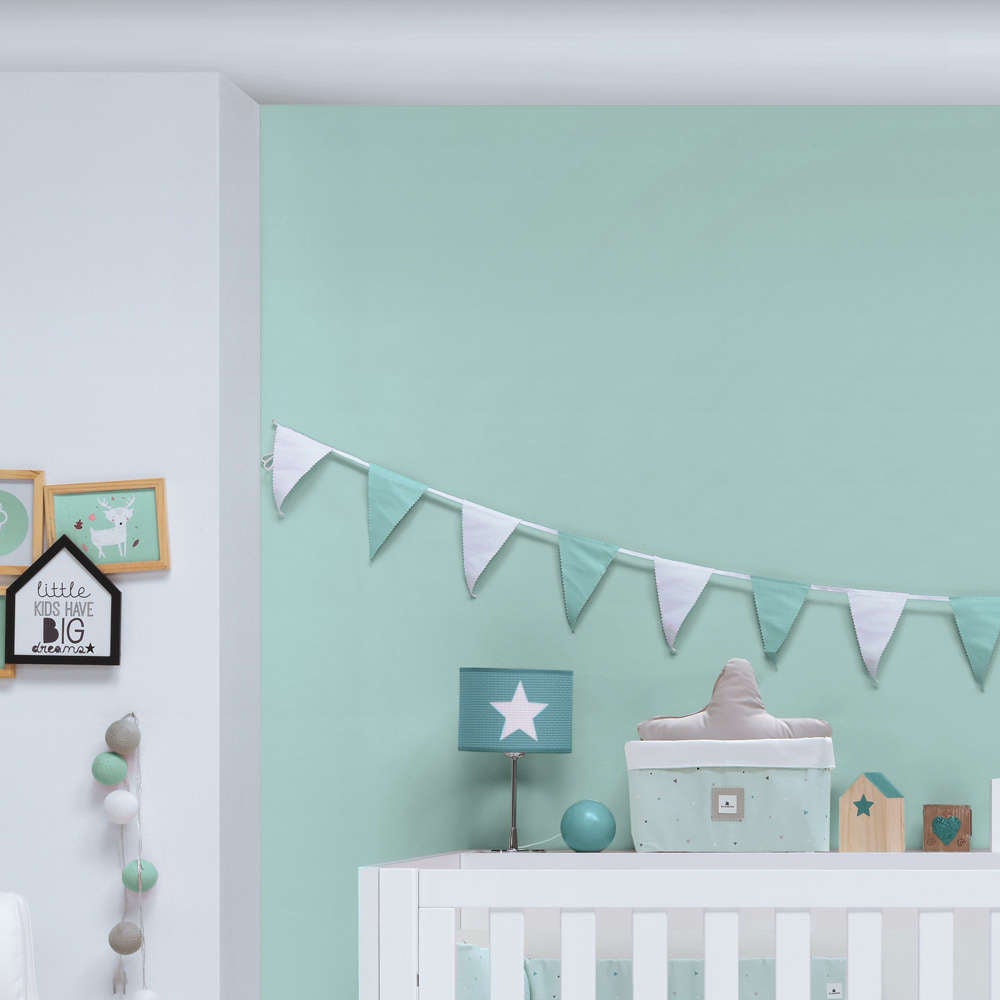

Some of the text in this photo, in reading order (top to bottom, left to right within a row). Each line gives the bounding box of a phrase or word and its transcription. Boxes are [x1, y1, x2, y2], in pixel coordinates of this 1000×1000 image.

[37, 581, 92, 599] little
[34, 600, 94, 617] KIDS HAVE
[43, 617, 85, 645] BIG
[31, 641, 86, 654] dreams
